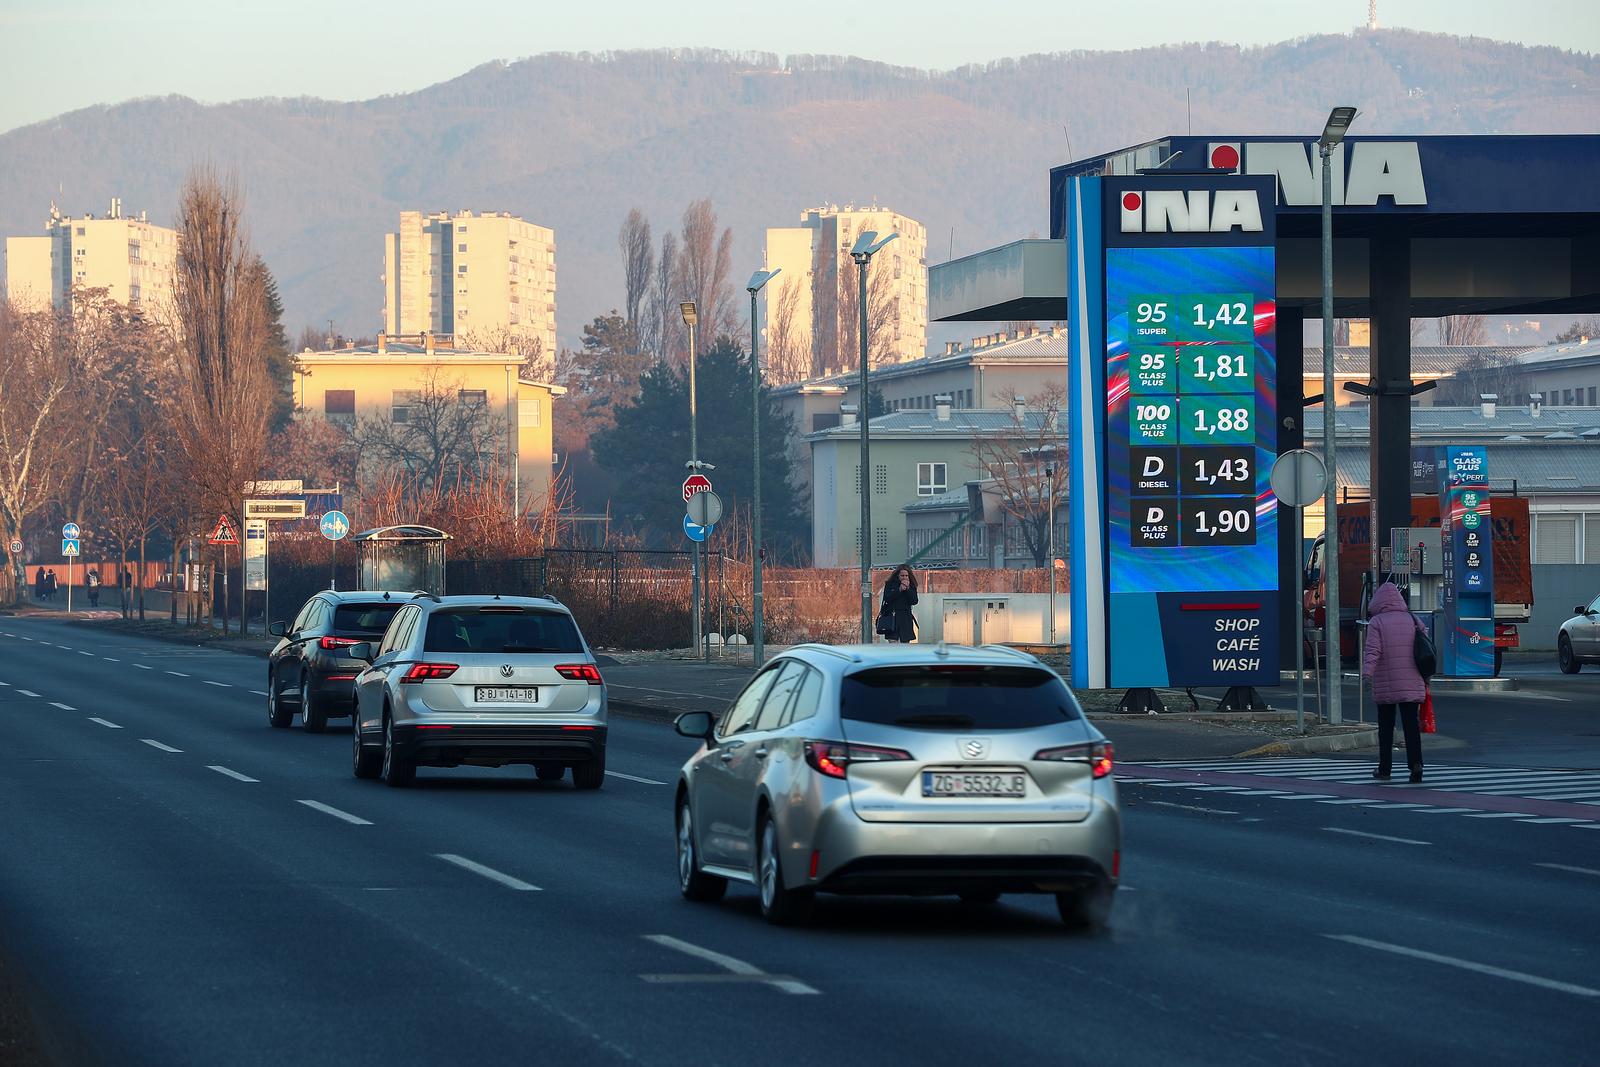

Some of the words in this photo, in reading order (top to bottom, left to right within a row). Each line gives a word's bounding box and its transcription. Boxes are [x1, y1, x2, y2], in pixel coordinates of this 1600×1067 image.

[1136, 303, 1168, 323] 95
[1193, 303, 1248, 329] 1,42
[1140, 354, 1165, 370] 95
[1193, 355, 1248, 382] 1,81
[1136, 405, 1171, 421] 100
[1193, 408, 1249, 435] 1,88
[1143, 456, 1165, 477] D
[1194, 458, 1249, 485] 1,43
[1146, 507, 1165, 523] D
[1194, 509, 1250, 536] 1,90
[1465, 514, 1477, 522] 95
[1468, 532, 1477, 540] D
[1214, 618, 1260, 632] SHOP
[1216, 634, 1261, 651] CAFÉ
[1212, 658, 1261, 672] WASH
[488, 690, 497, 698] BJ
[505, 690, 532, 699] 141-18
[935, 775, 953, 792] ZG
